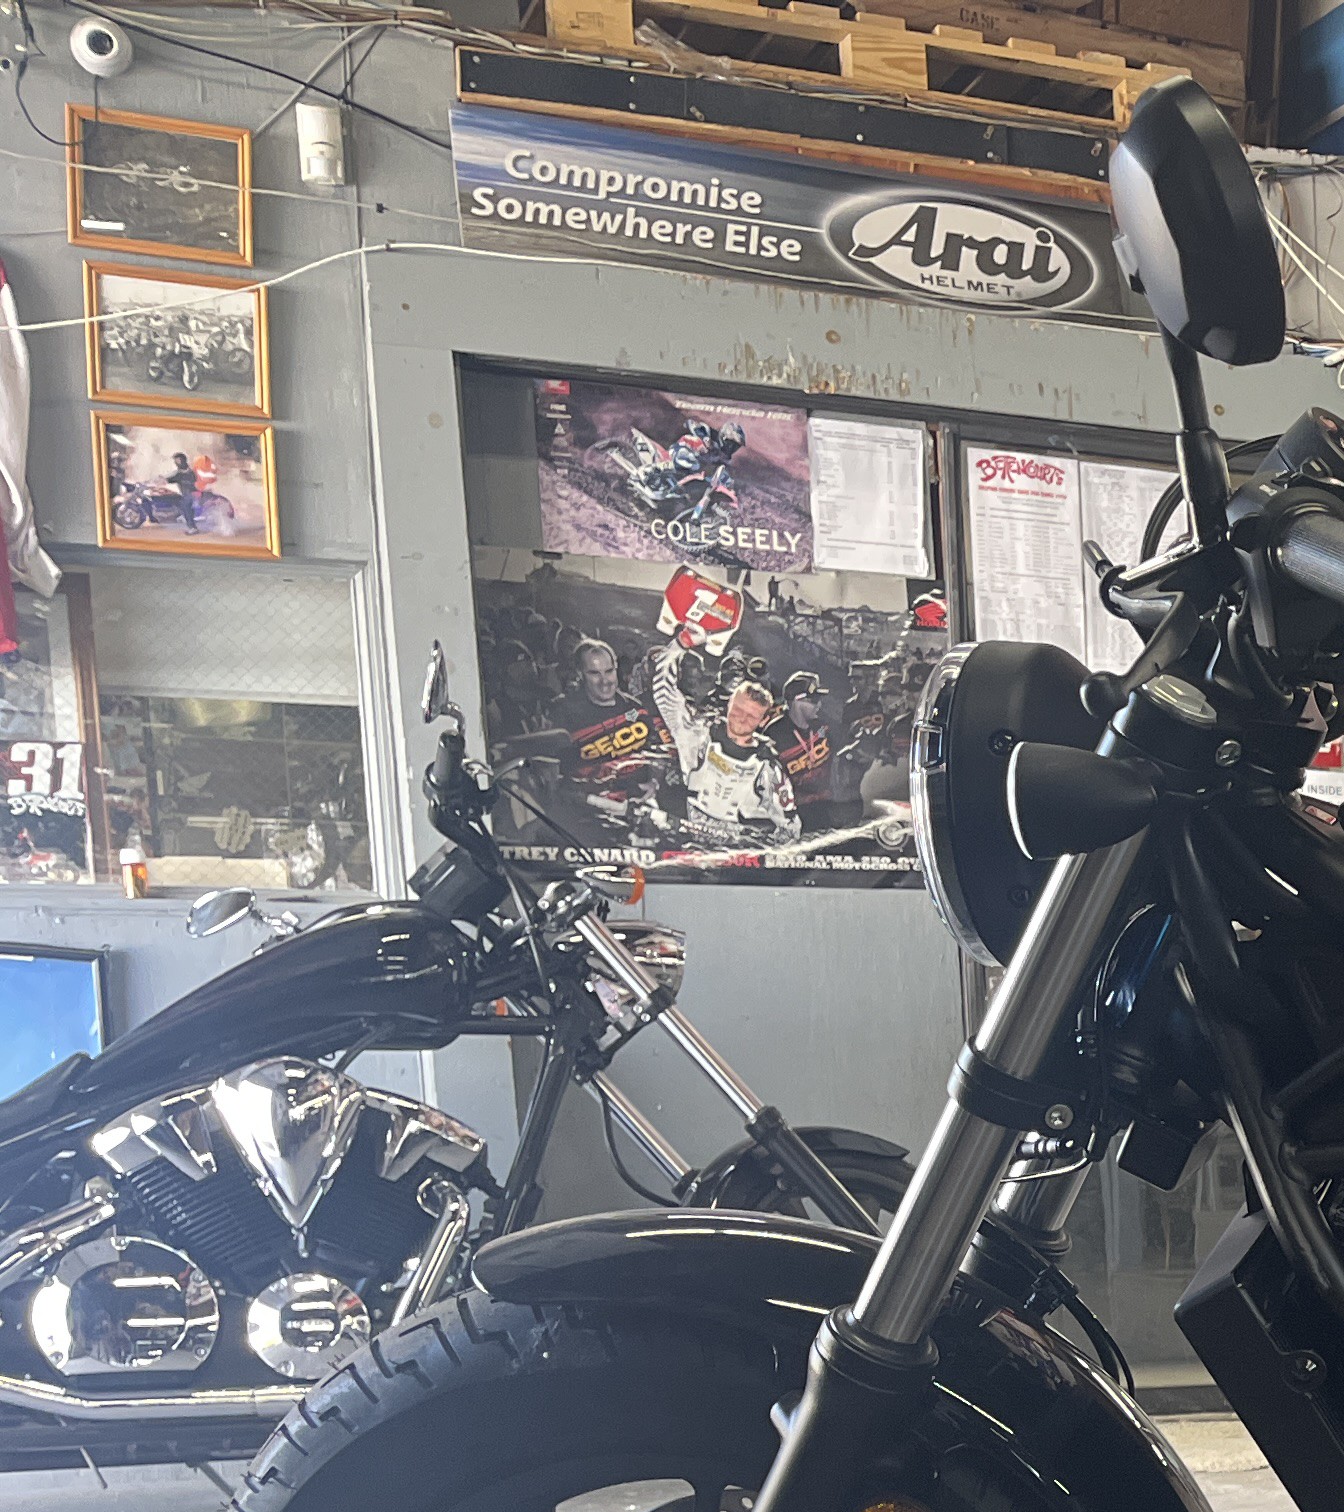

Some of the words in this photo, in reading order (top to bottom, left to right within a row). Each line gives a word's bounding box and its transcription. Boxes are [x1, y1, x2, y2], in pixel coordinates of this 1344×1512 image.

[504, 149, 763, 214] Compromise
[470, 186, 715, 250] Somewhere
[724, 222, 803, 262] Else
[850, 204, 1062, 284] Arai
[920, 272, 1015, 298] HELMET
[651, 518, 712, 544] COLE
[718, 524, 802, 553] SEELY
[579, 720, 649, 761] GEICO
[7, 741, 85, 800] 31
[1307, 784, 1343, 796] INSIDE
[499, 845, 559, 861] TREY
